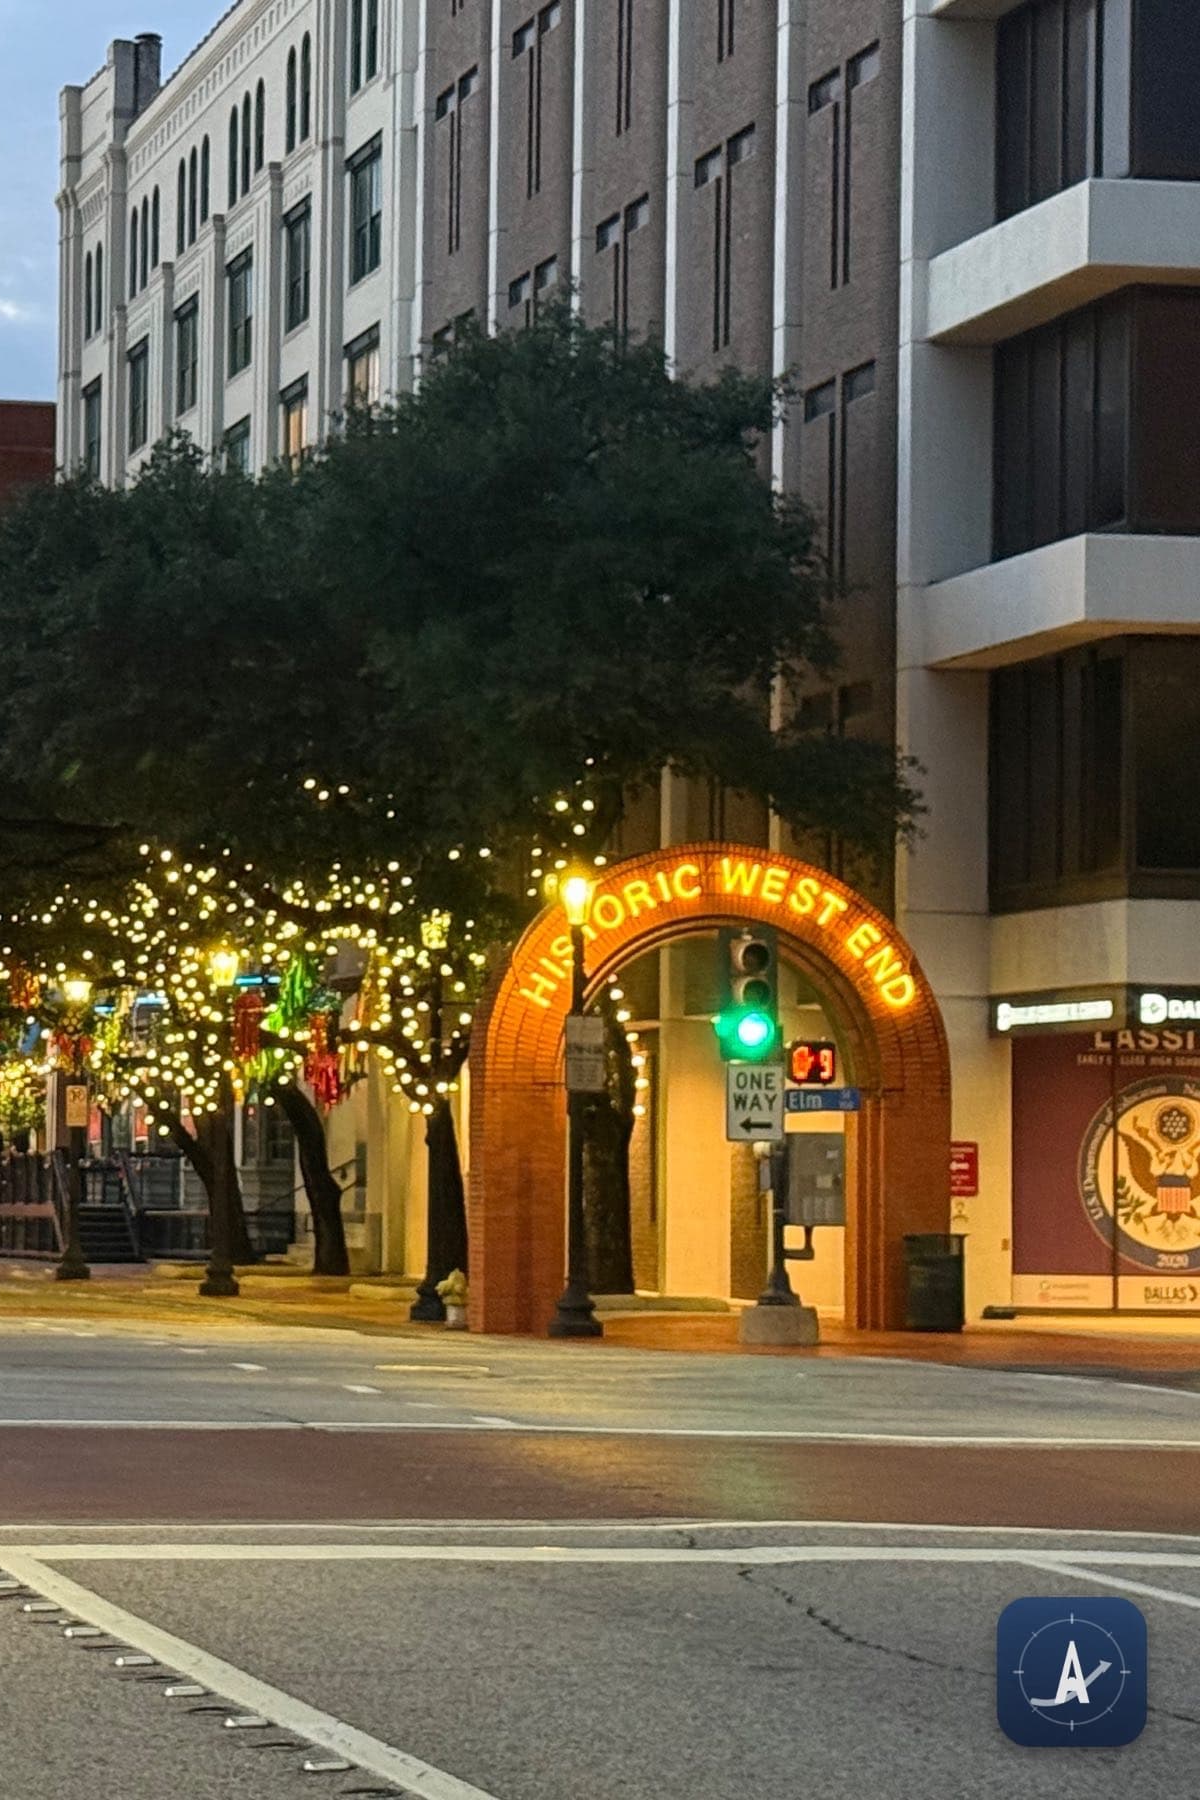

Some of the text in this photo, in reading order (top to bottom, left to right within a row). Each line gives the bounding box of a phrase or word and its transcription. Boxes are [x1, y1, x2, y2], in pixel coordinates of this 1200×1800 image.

[721, 856, 849, 926] WEST
[847, 922, 915, 1007] END
[820, 1049, 833, 1080] 9
[735, 1072, 776, 1090] ONE
[733, 1093, 778, 1111] WAY
[789, 1091, 822, 1109] Elm
[1144, 1286, 1187, 1300] DALLAS
